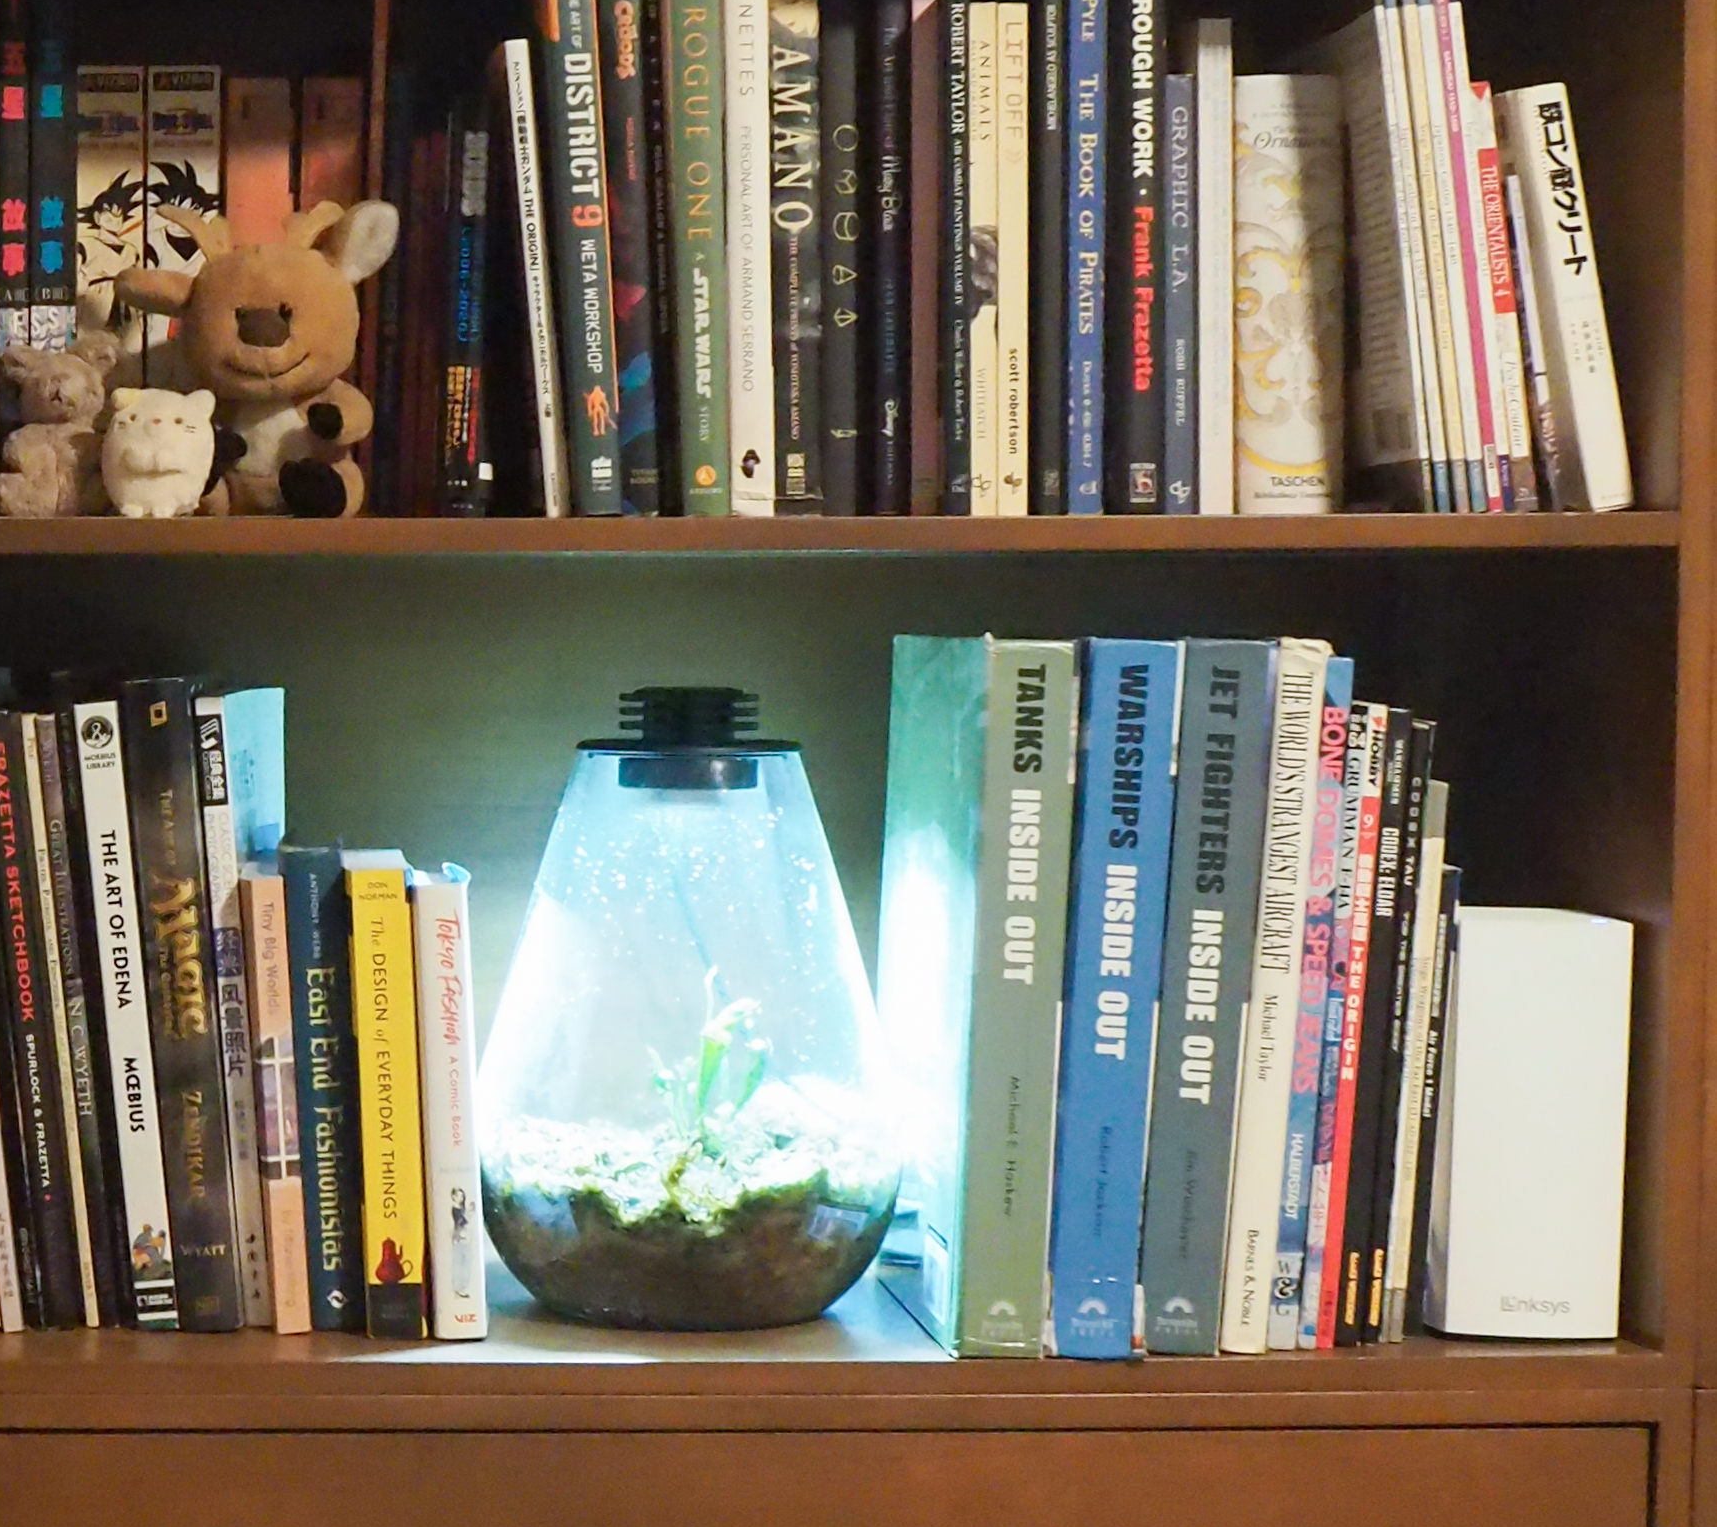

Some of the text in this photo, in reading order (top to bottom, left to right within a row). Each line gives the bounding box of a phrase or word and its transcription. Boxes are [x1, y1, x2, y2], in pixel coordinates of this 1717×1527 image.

[569, 12, 581, 32] ART
[570, 36, 581, 48] OF
[951, 3, 965, 133] ROBERT TAYLOR
[564, 53, 597, 197] DISTRICT
[683, 8, 712, 242] ROGUE ONE
[979, 40, 991, 142] ANIMALS
[1005, 22, 1023, 139] LIFT OFF
[1078, 74, 1097, 120] THE
[773, 45, 813, 232] AMANO
[1078, 132, 1098, 198] BOOK
[1132, 99, 1154, 178] WORK
[1541, 101, 1587, 275] 鉄コン筋クリート
[572, 204, 602, 227] 9
[1078, 210, 1095, 239] OF
[1134, 205, 1154, 277] Frank
[1172, 106, 1188, 293] GRAPHIC L.A.
[1481, 166, 1510, 297] THE ORIENTALISTS 4
[581, 239, 604, 373] WETA WORKSHOP
[1078, 250, 1098, 334] PIRATES
[1134, 285, 1154, 391] Frazetta
[1008, 348, 1019, 454] scott robertson
[1004, 664, 1045, 985] TANKS INSIDE OUT
[1095, 664, 1147, 1059] WARSHIPS INSIDE OUT
[1261, 672, 1313, 974] THE WORLD'S STRANGEST AIRCRAFT
[1376, 826, 1400, 916] CODEX: ELDAR
[99, 831, 132, 1008] THE ART OF EDENA
[1179, 666, 1237, 1103] JET FIGHTERS INSIDE OUT
[1293, 706, 1346, 1093] BONE DOMES & SPEED JEANS
[3, 865, 35, 1022] SKETCHBOOK
[371, 918, 396, 1219] The DESIGN of EVERYDAY THINGS
[1256, 994, 1275, 1082] Michael Taylor
[123, 1057, 144, 1133] MŒBIUS
[1284, 1133, 1304, 1220] HALBERSTADT
[1501, 1296, 1570, 1313] Linksys
